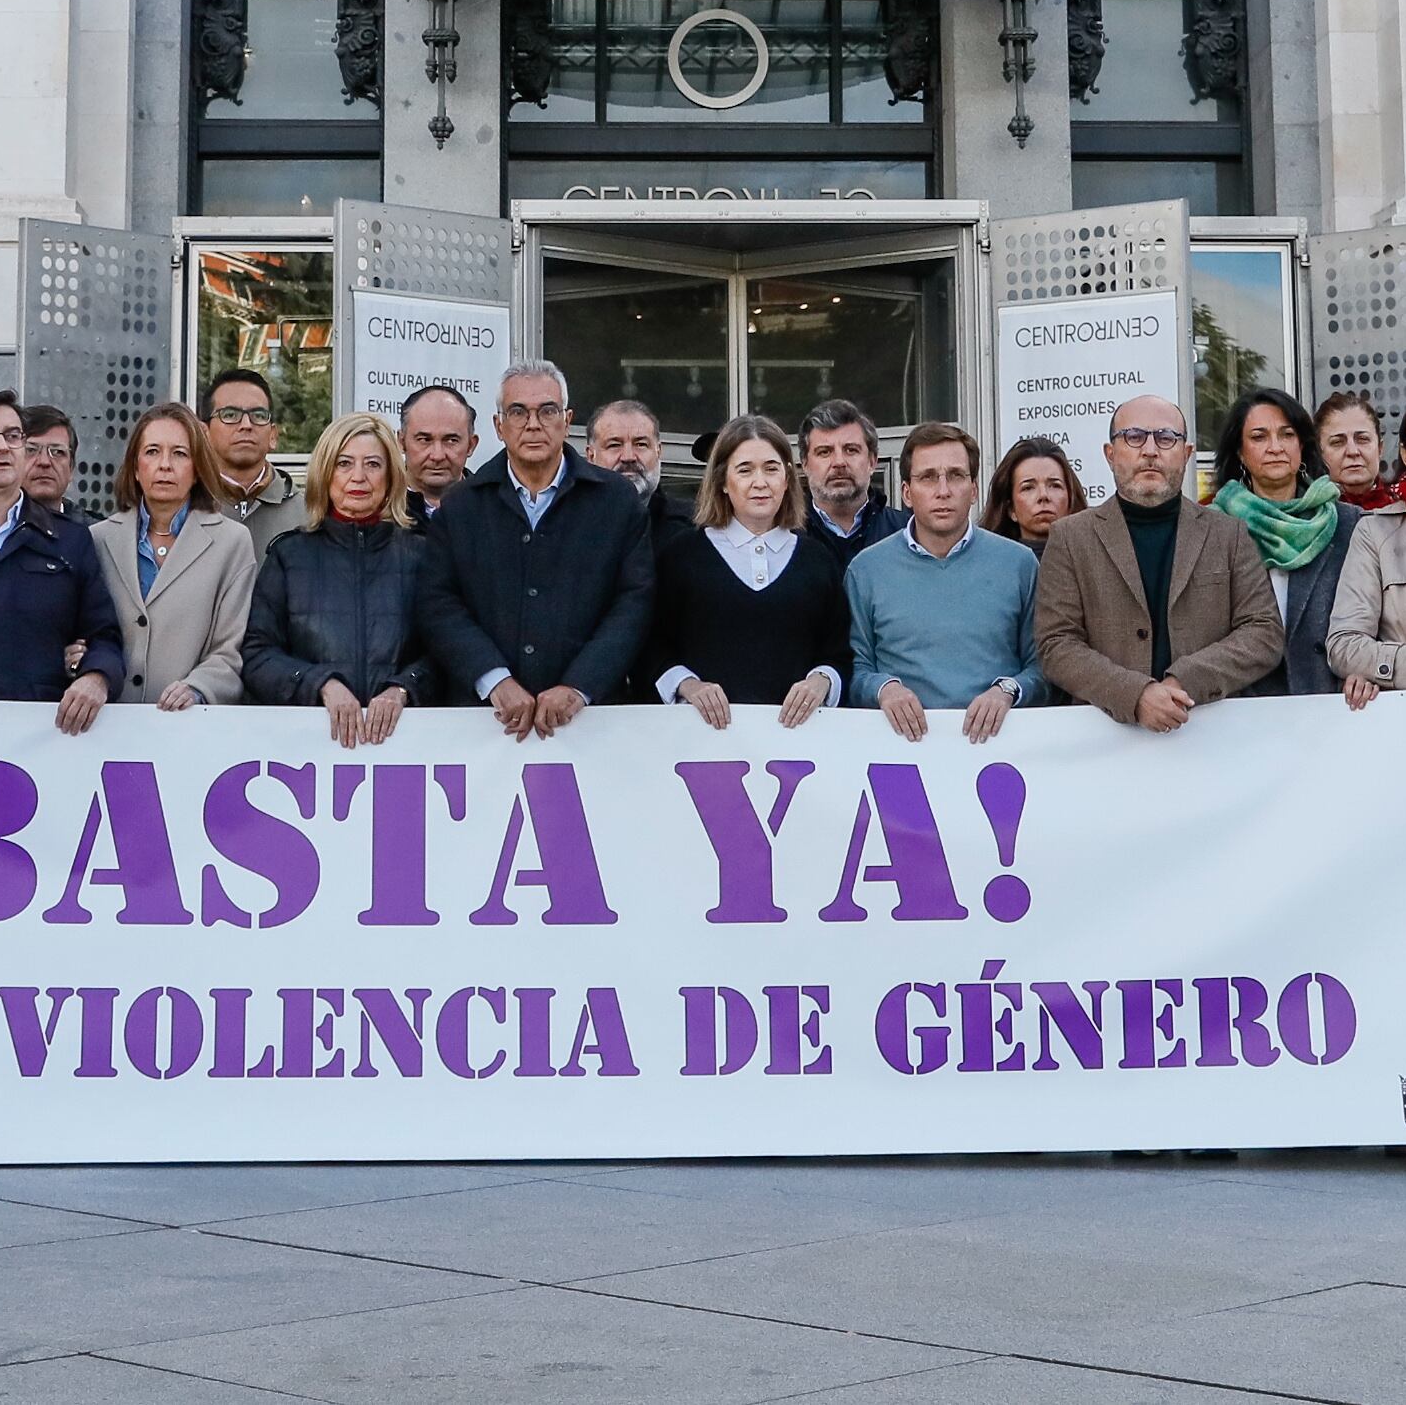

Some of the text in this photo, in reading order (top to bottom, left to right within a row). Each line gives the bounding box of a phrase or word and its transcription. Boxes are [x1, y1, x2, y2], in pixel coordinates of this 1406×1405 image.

[367, 370, 481, 393] CULTURAL CENTRE
[1017, 371, 1145, 393] CENTRO CULTURAL
[1018, 400, 1116, 421] EXPOSICIONES
[674, 760, 1031, 924] YA!
[679, 985, 833, 1076] DE
[874, 959, 1357, 1075] GÉNERO
